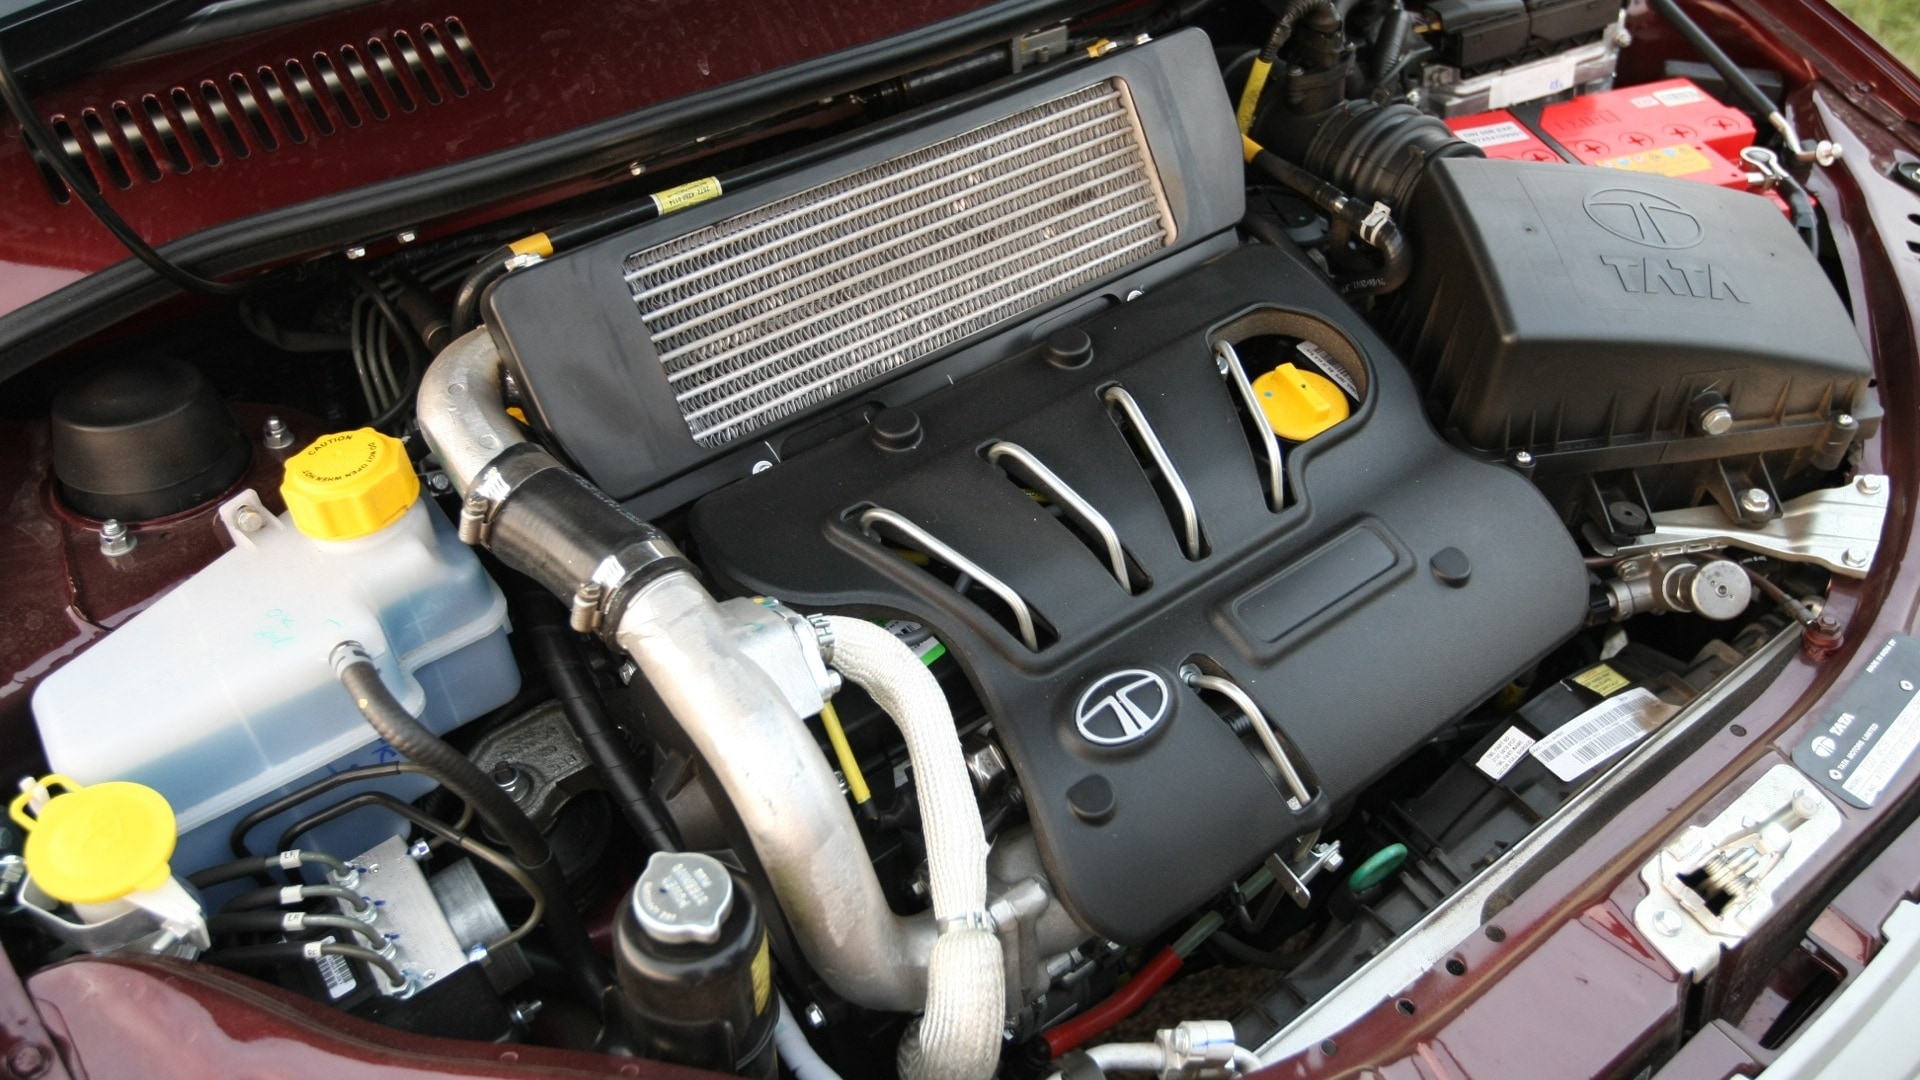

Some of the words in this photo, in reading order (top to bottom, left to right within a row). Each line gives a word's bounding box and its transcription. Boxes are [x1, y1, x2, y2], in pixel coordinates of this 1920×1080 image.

[1599, 254, 1751, 304] TATA
[308, 435, 353, 455] CAUTION
[366, 450, 377, 463] NOT
[302, 469, 315, 480] HOT
[345, 463, 368, 478] OPEN
[1829, 712, 1855, 737] TATA
[1837, 757, 1849, 771] TATA
[1847, 740, 1865, 759] MOTORS
[1861, 723, 1879, 741] LIMITED
